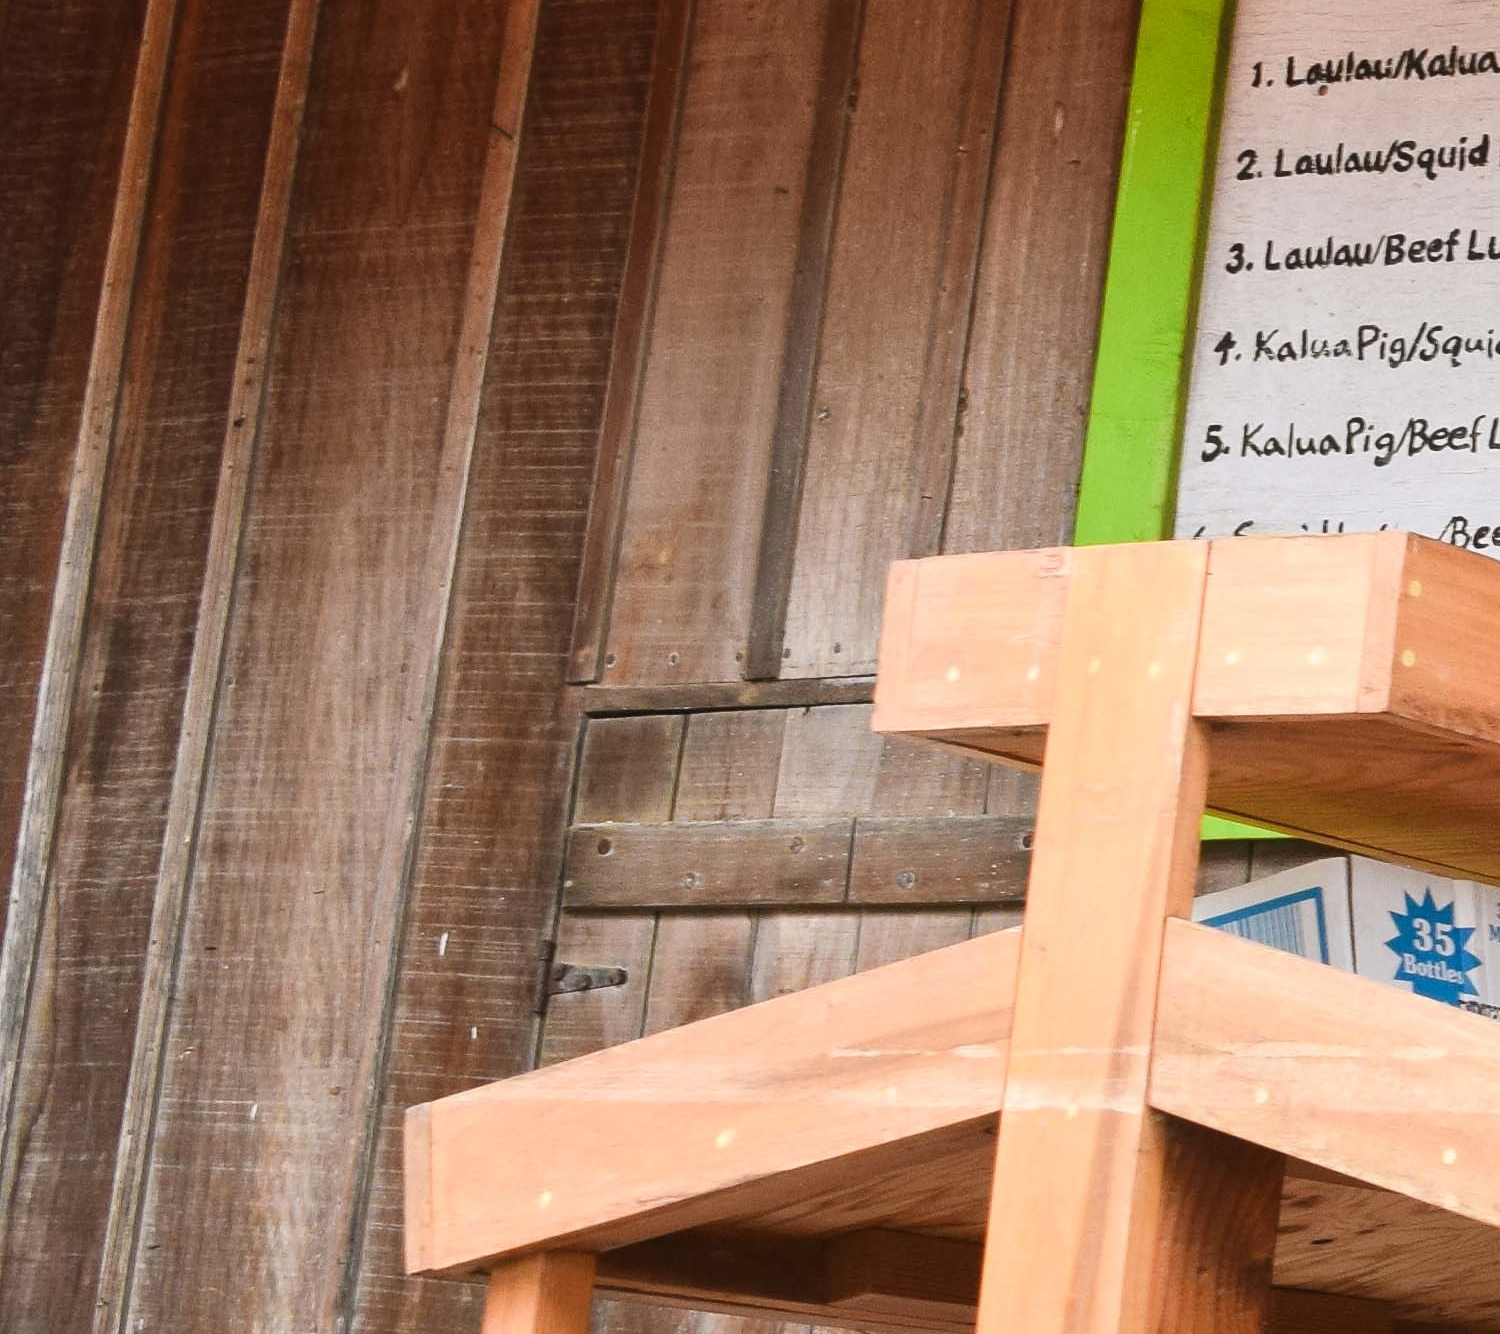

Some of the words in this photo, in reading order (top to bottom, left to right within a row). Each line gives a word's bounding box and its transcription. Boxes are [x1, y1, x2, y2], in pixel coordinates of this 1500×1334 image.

[1251, 61, 1274, 88] 1.
[1236, 148, 1263, 181] 2.
[1224, 242, 1254, 275] 3.
[1213, 331, 1242, 366] 4.
[1253, 329, 1353, 363] Kalua
[1200, 424, 1231, 463] 5.
[1240, 422, 1342, 459] Kalua
[1412, 918, 1456, 956] 35
[1403, 953, 1464, 985] Bottles
